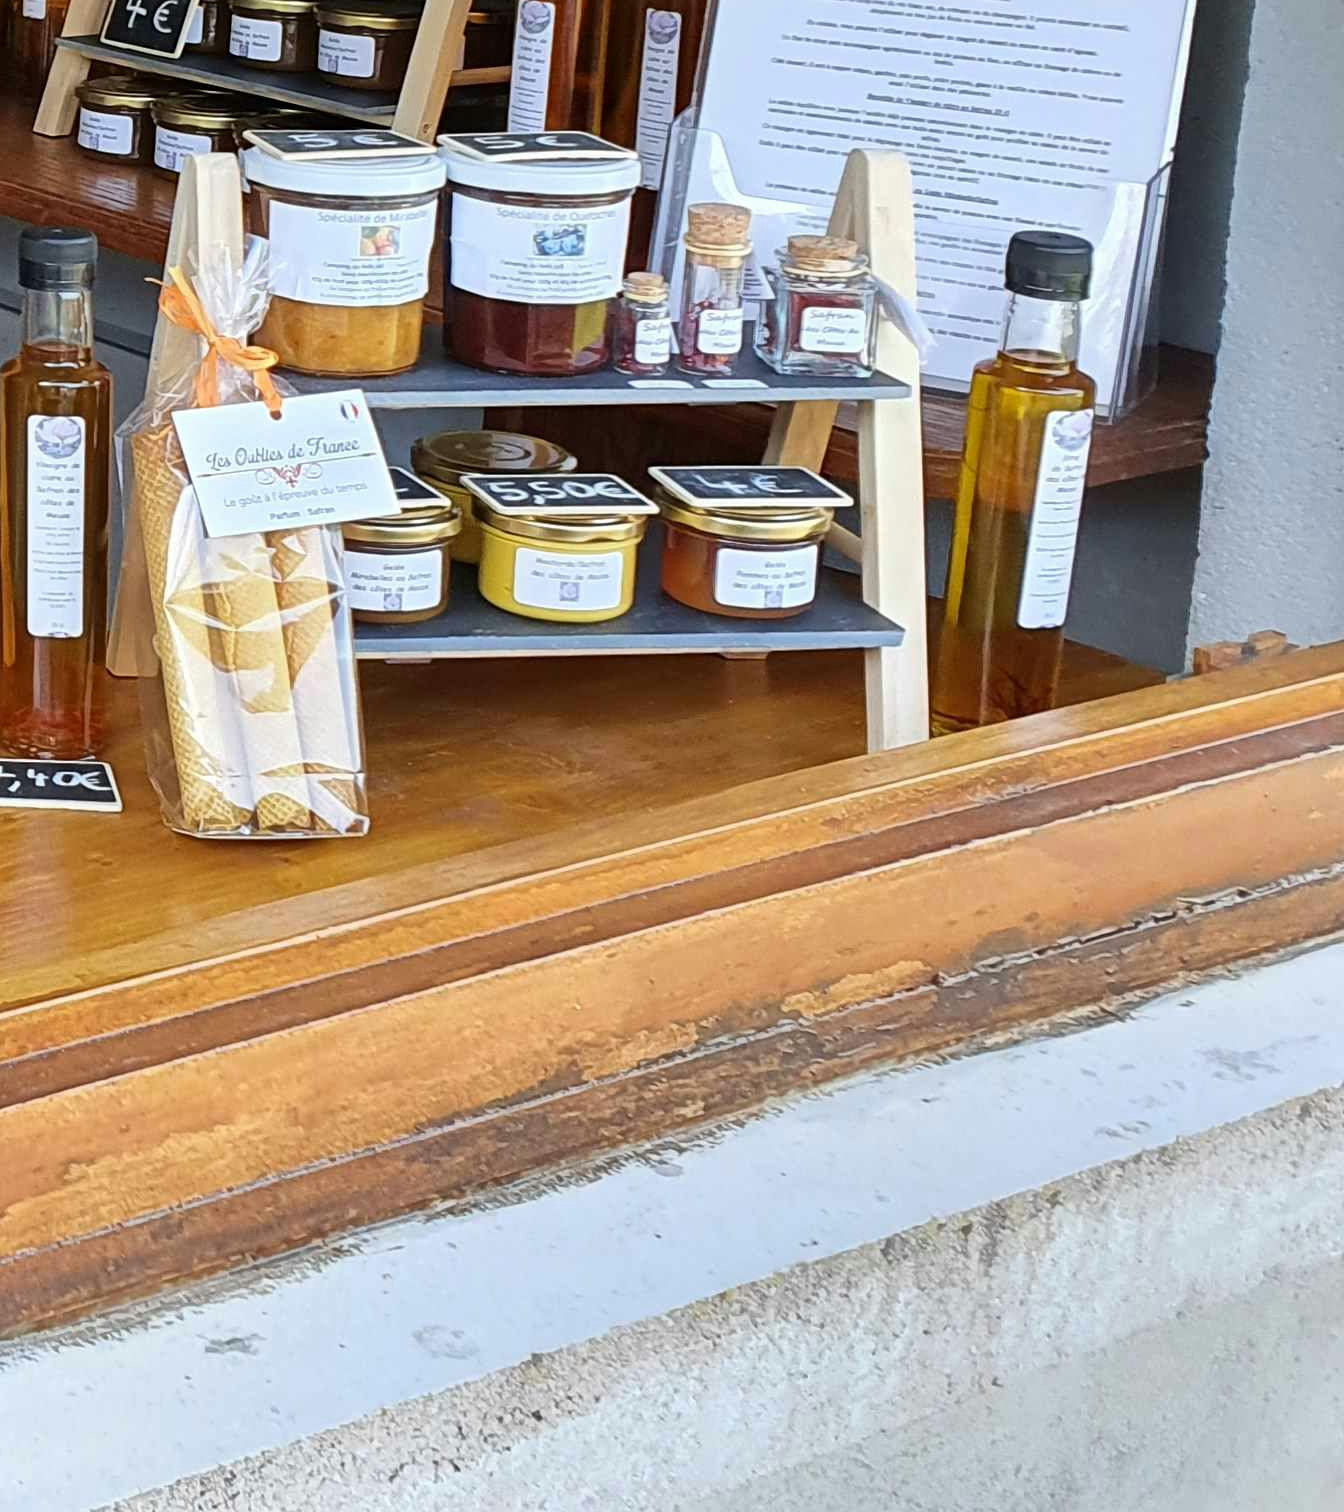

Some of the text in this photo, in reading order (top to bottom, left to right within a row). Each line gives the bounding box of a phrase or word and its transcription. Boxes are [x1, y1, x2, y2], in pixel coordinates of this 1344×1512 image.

[374, 214, 387, 223] de
[206, 452, 231, 471] Les
[287, 443, 304, 459] de
[307, 437, 360, 456] France
[224, 498, 236, 508] Le
[239, 495, 262, 508] goût
[322, 486, 334, 495] du
[336, 482, 368, 493] temps
[488, 481, 632, 505] 5,50€
[270, 510, 300, 520] Parfum
